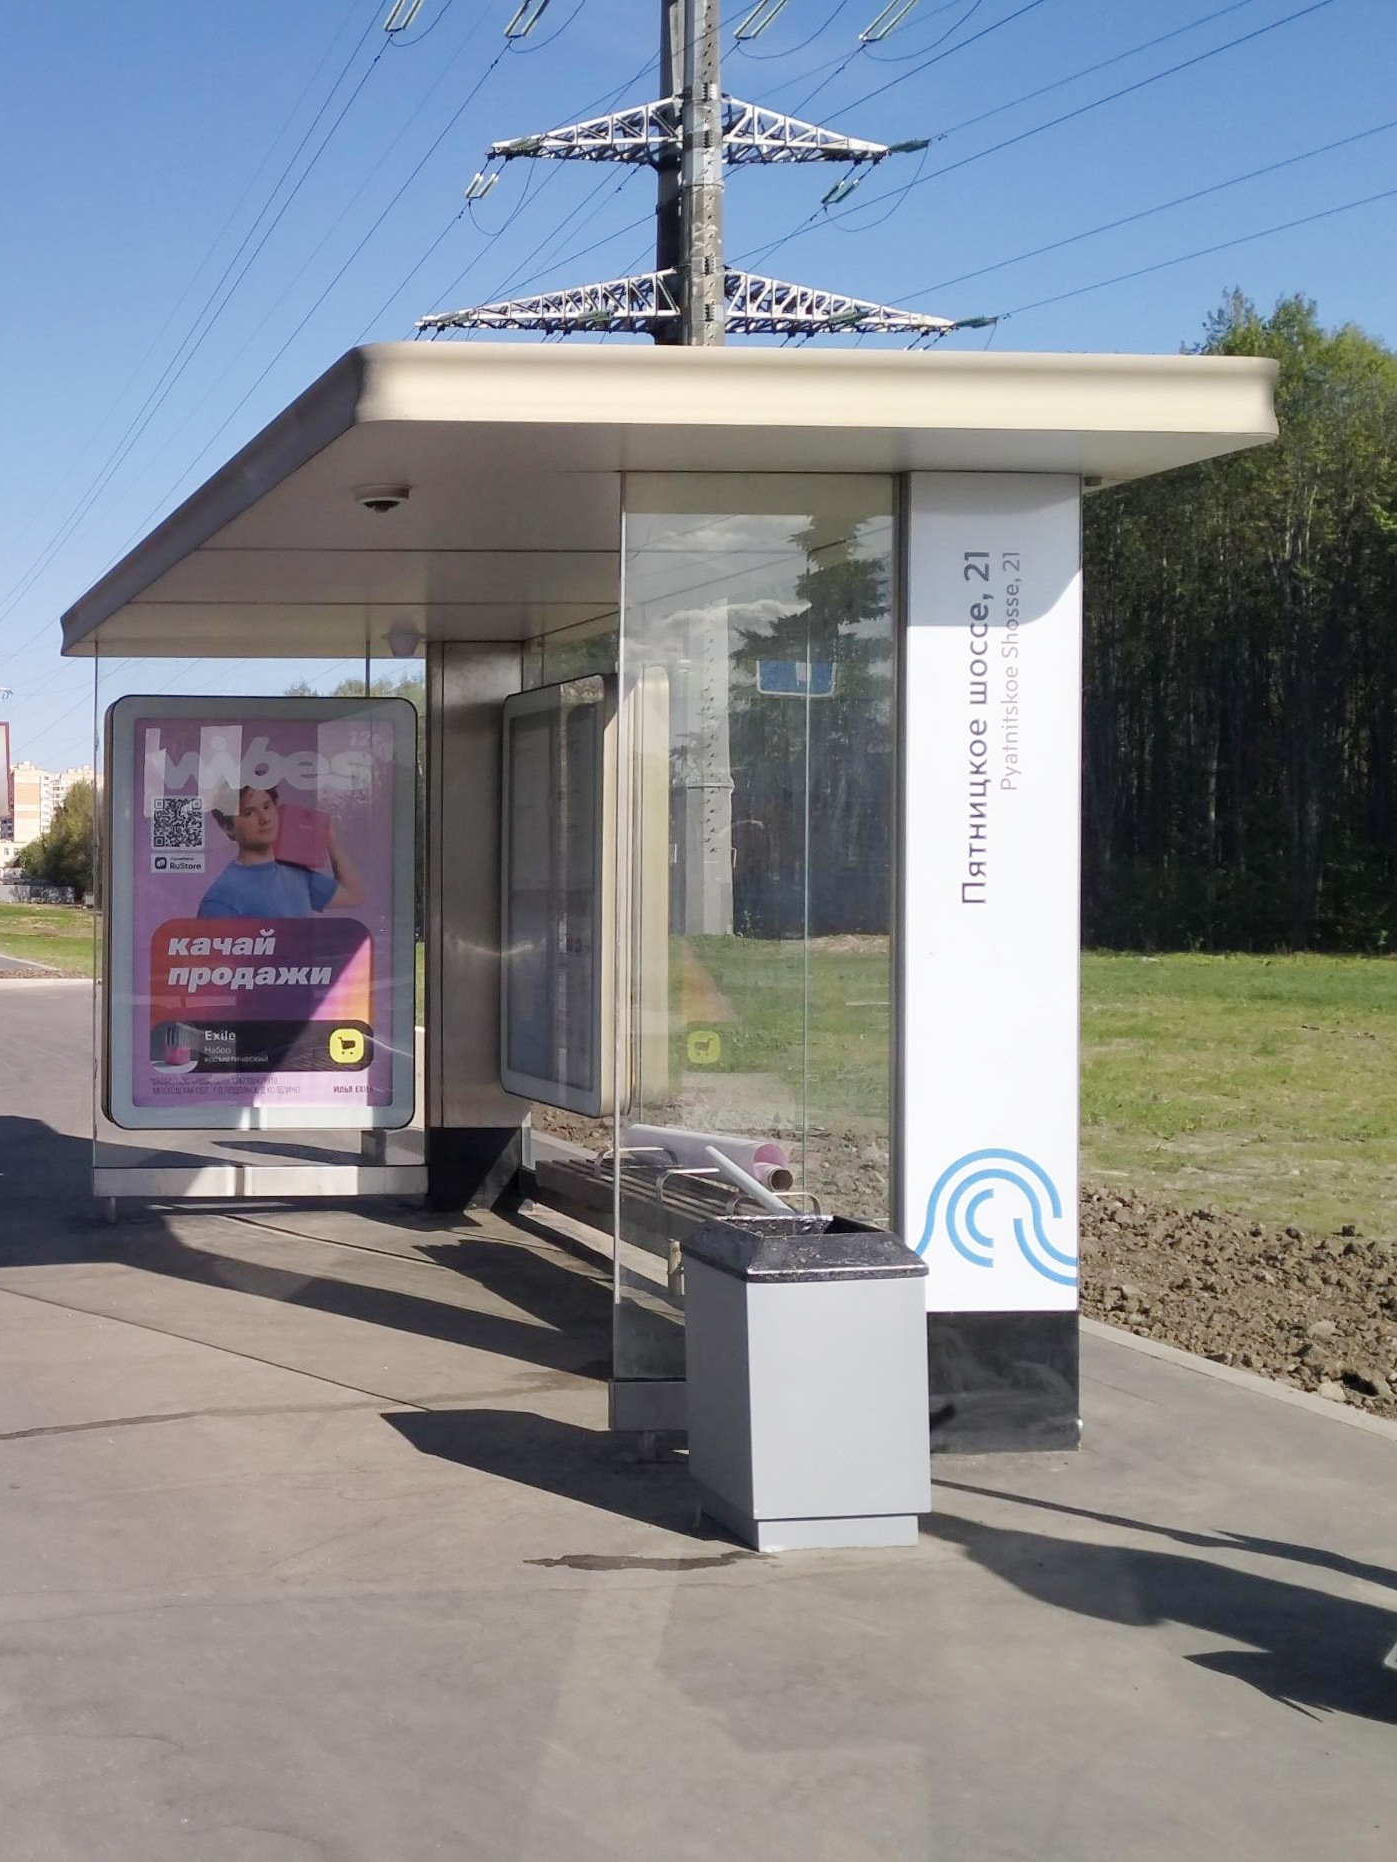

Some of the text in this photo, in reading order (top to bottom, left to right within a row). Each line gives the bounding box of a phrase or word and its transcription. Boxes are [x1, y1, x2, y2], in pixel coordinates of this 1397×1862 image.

[1000, 552, 1022, 791] Pyatnitskoe Shosse, 21
[962, 551, 994, 904] Пятницкое шоссе, 21
[167, 928, 276, 956] качай
[167, 966, 332, 993] продажи
[204, 1030, 236, 1041] Exile
